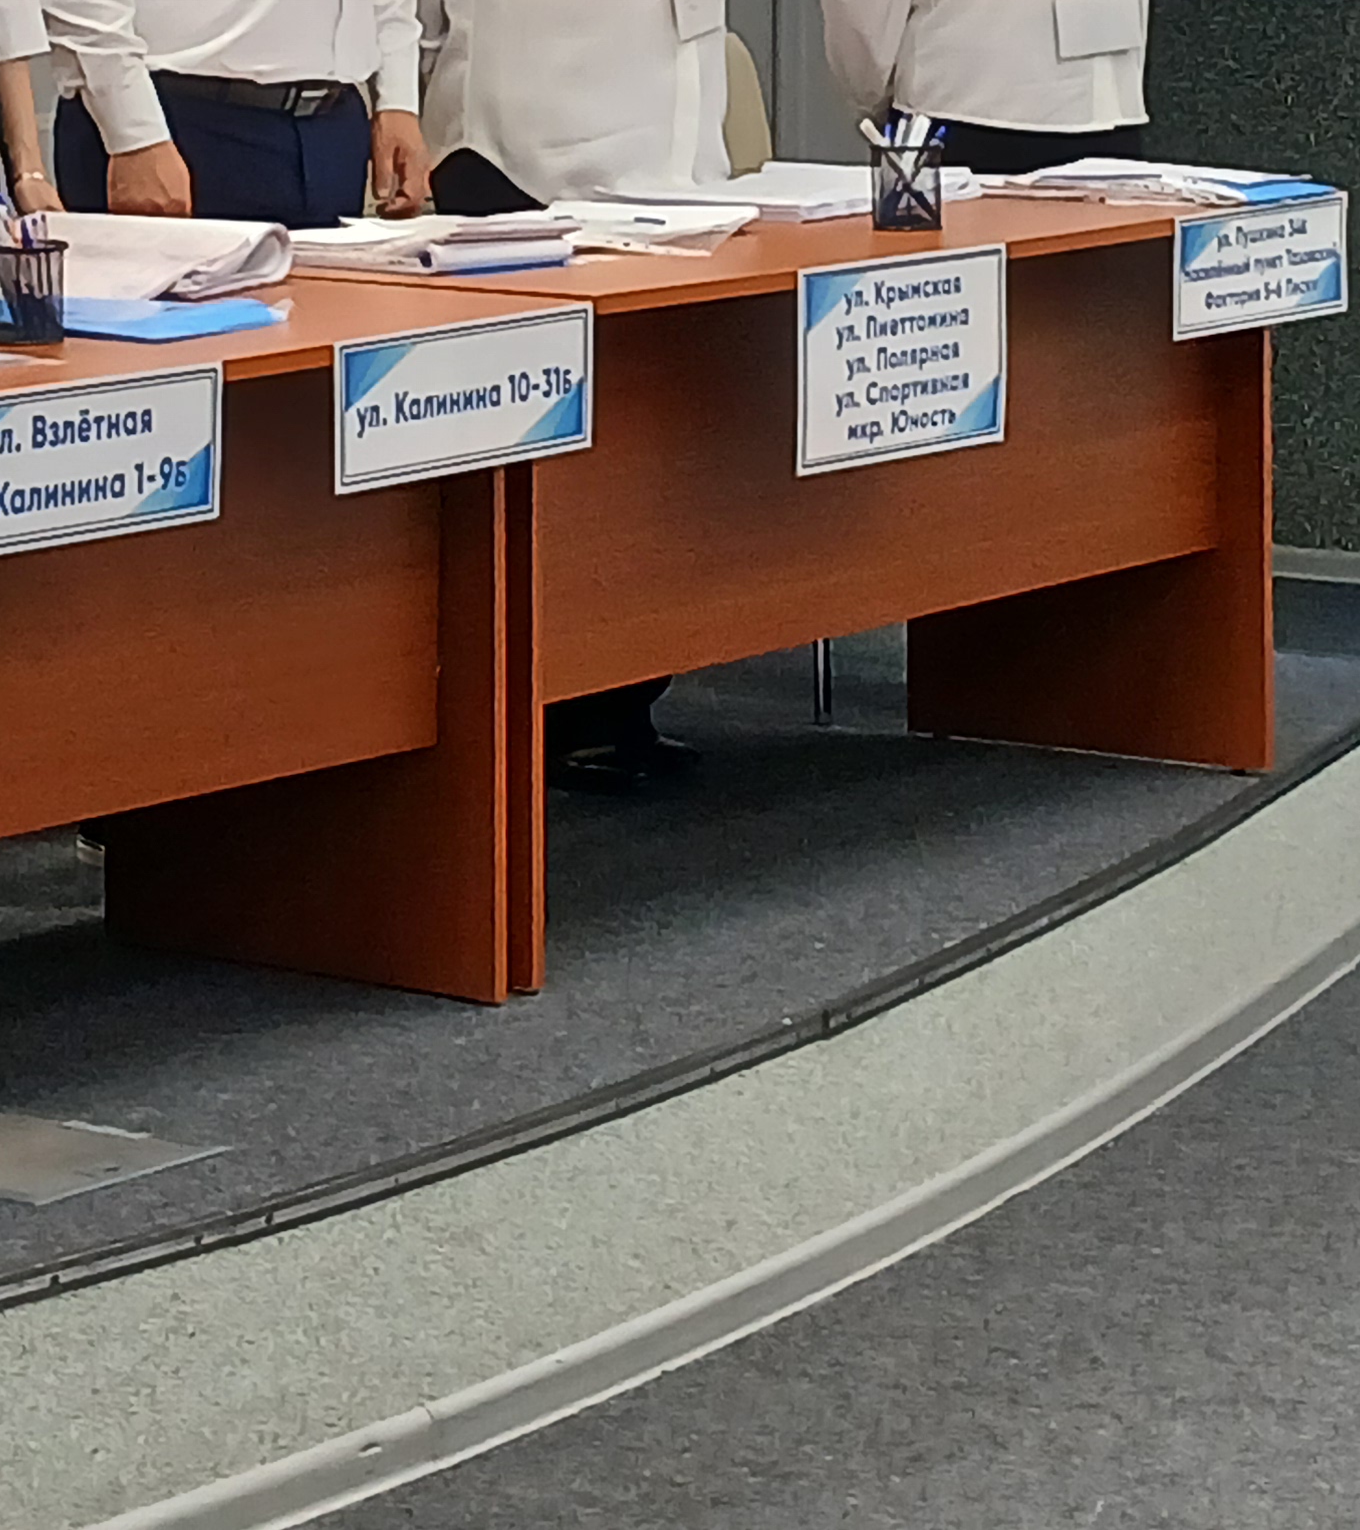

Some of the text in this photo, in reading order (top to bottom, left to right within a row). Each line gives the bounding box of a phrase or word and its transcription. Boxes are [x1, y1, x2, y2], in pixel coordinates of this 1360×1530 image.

[844, 276, 962, 316] ул. Крымская
[836, 325, 861, 350] ул.
[846, 342, 960, 381] ул. Полярная
[356, 405, 388, 438] ул.
[394, 385, 501, 424] Калинина
[836, 373, 969, 417] ул. Спортивная
[31, 409, 152, 449] Взлётная
[848, 409, 956, 444] мкр. Юность
